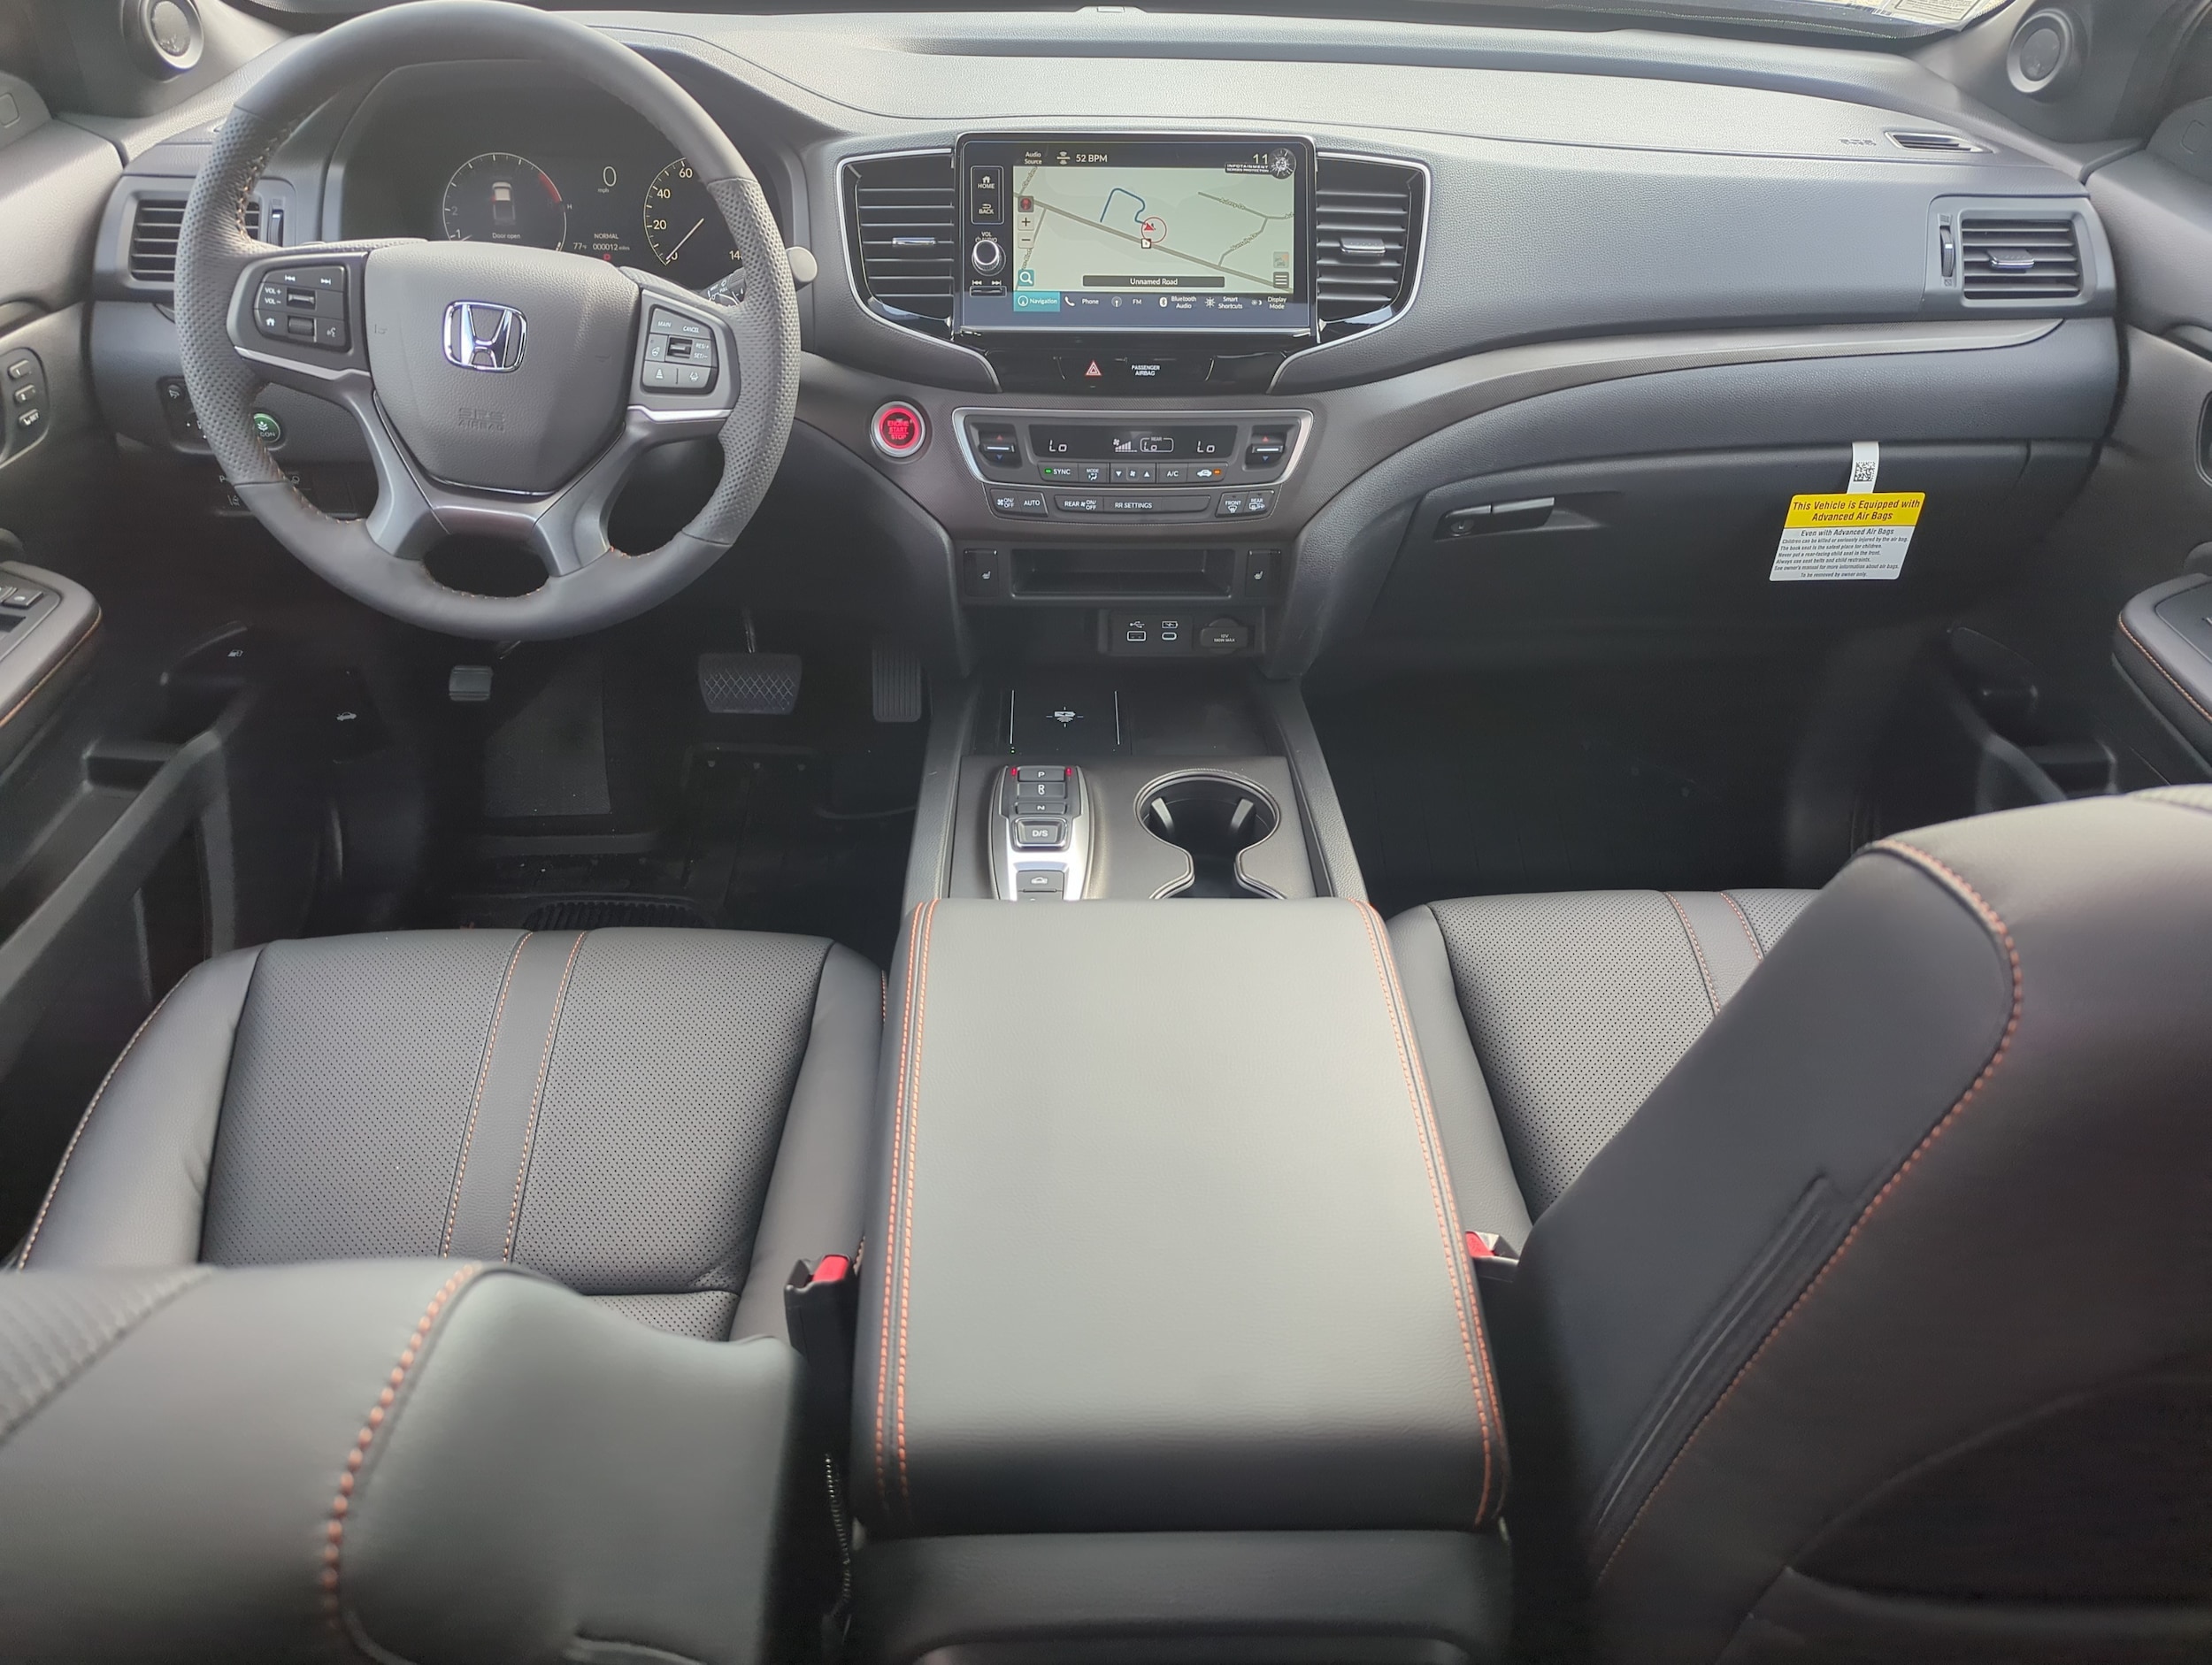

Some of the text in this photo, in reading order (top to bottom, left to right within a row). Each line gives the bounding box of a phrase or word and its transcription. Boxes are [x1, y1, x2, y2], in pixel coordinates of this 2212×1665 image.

[1075, 154, 1108, 163] 52 BPM
[603, 165, 617, 187] 0
[679, 167, 693, 178] 60
[657, 188, 671, 199] 40
[653, 219, 667, 230] 20
[1048, 439, 1068, 452] Lo
[1196, 441, 1216, 453] Lo
[1793, 499, 1921, 510] This Vehicle is Equipped with
[1811, 511, 1893, 522] Advanced Air Bags
[1878, 527, 1895, 536] Bags
[1032, 829, 1048, 838] D/S
